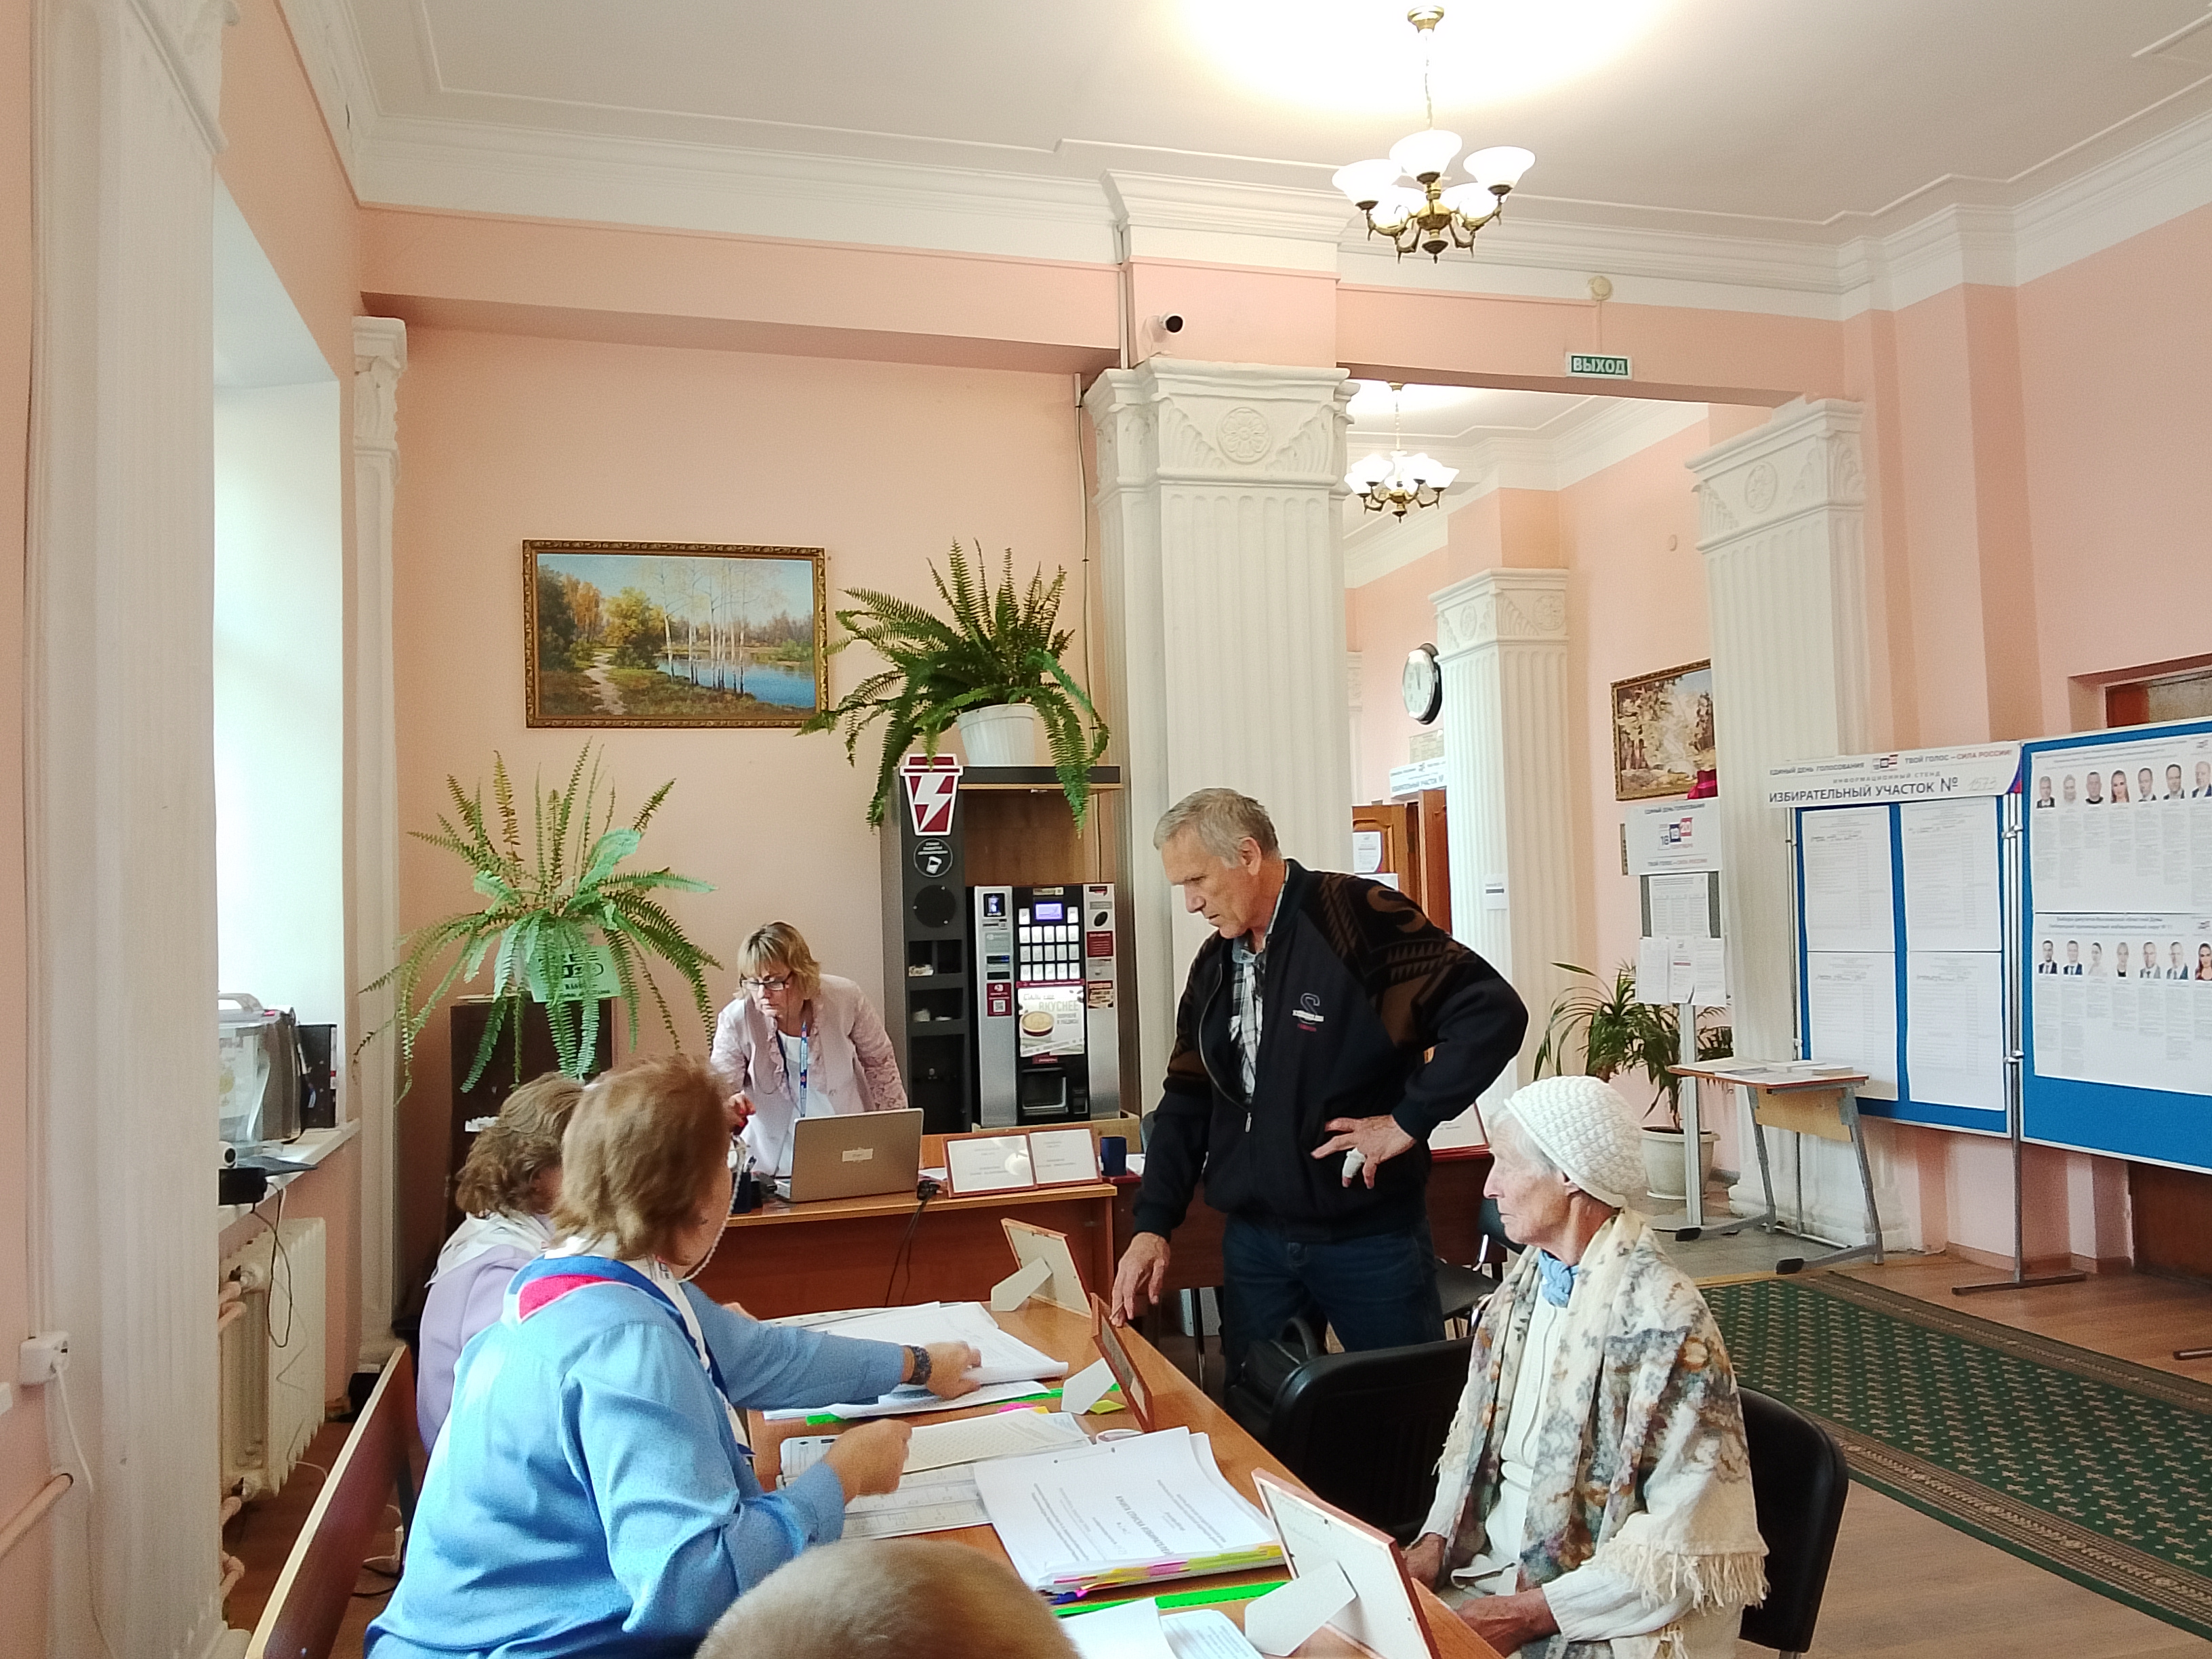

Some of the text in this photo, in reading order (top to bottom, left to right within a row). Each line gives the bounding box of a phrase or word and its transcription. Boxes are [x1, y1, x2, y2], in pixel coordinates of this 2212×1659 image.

[1573, 357, 1626, 374] ВЫХОД
[1905, 755, 1923, 764] ТВОЙ
[1925, 754, 1949, 762] ГОЛОС
[1832, 773, 1911, 783] ИНФОРМАЦИОННЫЙ
[1769, 784, 1872, 802] ИЗБИРАТЕЛЬНЫЙ
[1875, 781, 1935, 796] УЧАСТОК
